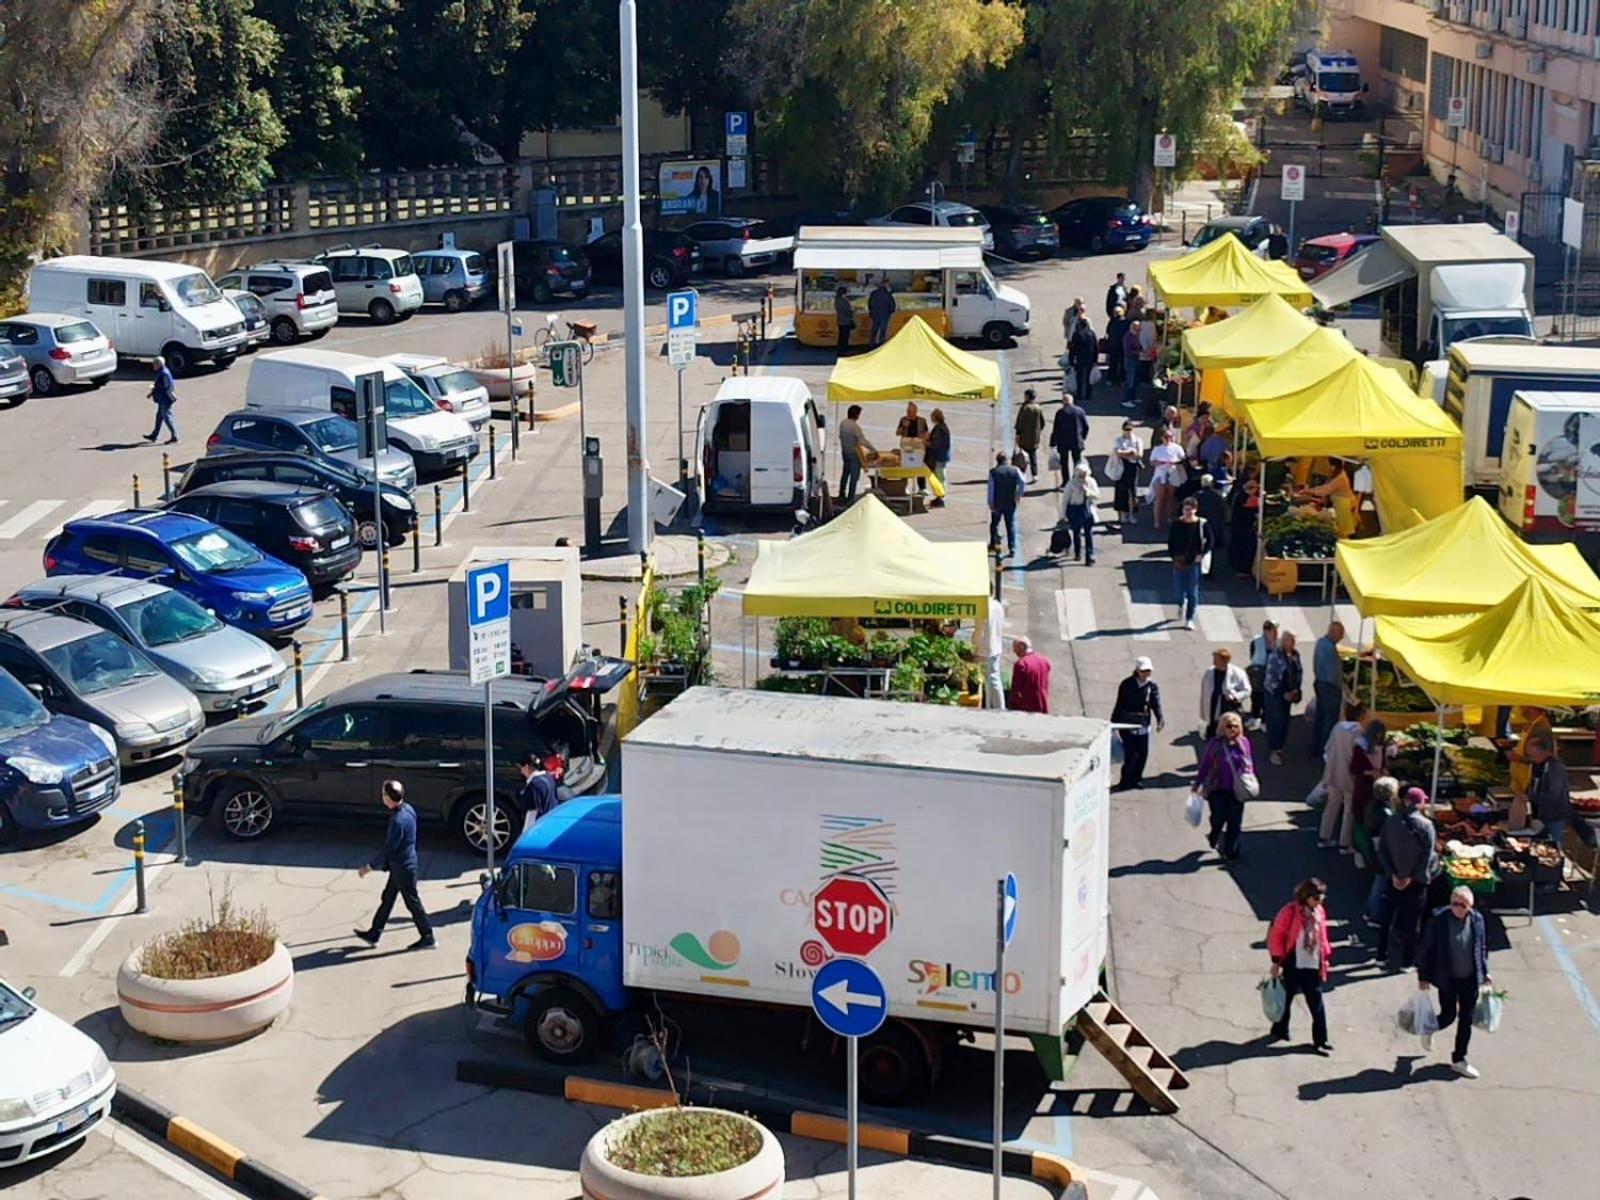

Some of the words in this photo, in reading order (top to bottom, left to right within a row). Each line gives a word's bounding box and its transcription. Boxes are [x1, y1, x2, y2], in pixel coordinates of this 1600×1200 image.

[730, 114, 742, 132] P
[673, 297, 689, 325] P
[1380, 437, 1446, 449] COLDIRETTI
[476, 572, 501, 618] P
[894, 601, 977, 616] COLDIRETTI
[817, 899, 885, 935] STOP
